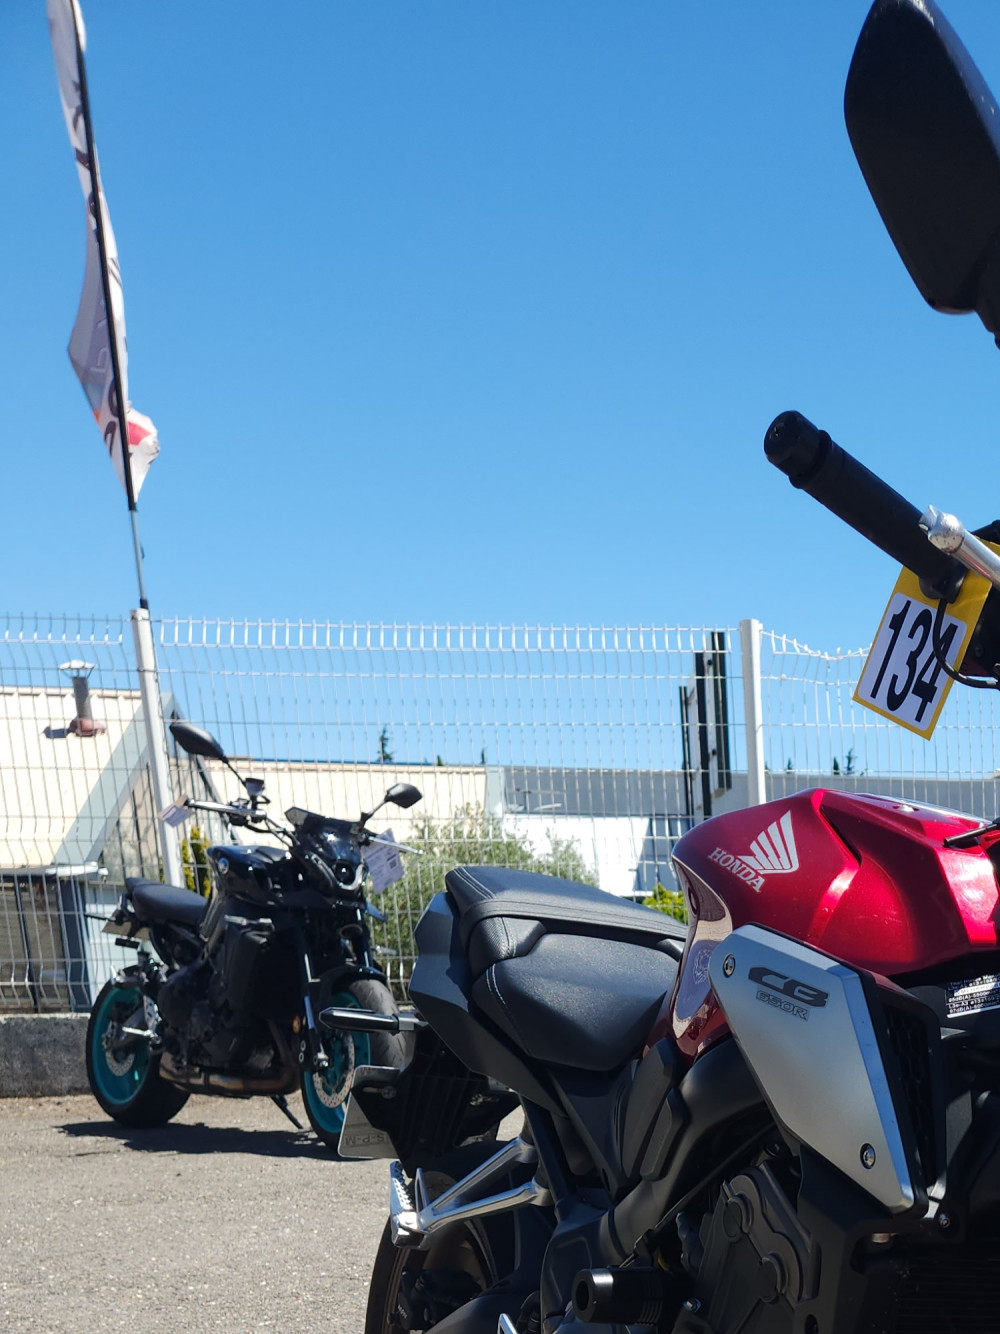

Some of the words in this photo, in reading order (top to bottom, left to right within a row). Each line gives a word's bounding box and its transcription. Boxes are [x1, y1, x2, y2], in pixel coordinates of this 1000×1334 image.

[869, 599, 959, 724] 134
[706, 846, 766, 894] HONDA
[747, 966, 830, 1008] CB
[755, 989, 809, 1022] 650R
